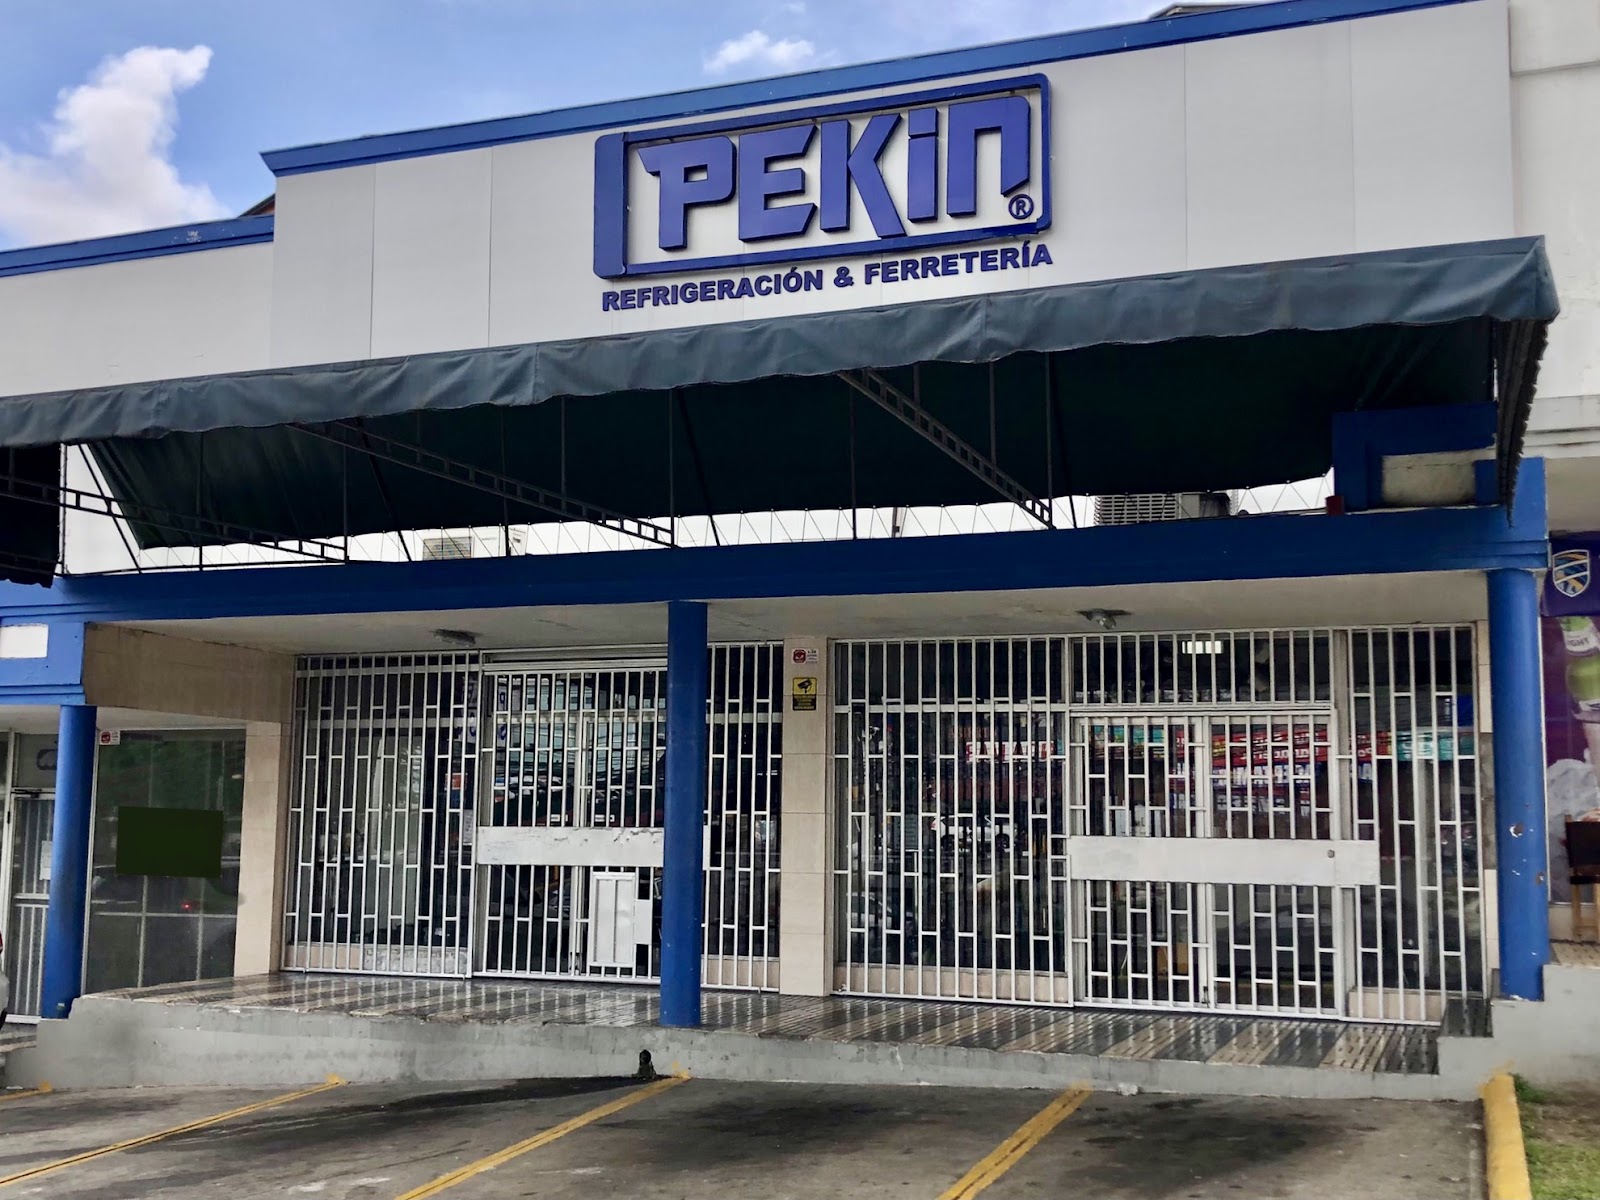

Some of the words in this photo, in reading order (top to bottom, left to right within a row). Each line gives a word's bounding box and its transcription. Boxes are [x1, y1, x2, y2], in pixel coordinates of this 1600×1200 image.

[602, 267, 823, 311] REFRIGERACIÓN
[833, 266, 855, 288] &
[864, 240, 1053, 285] FERRETERÍA
